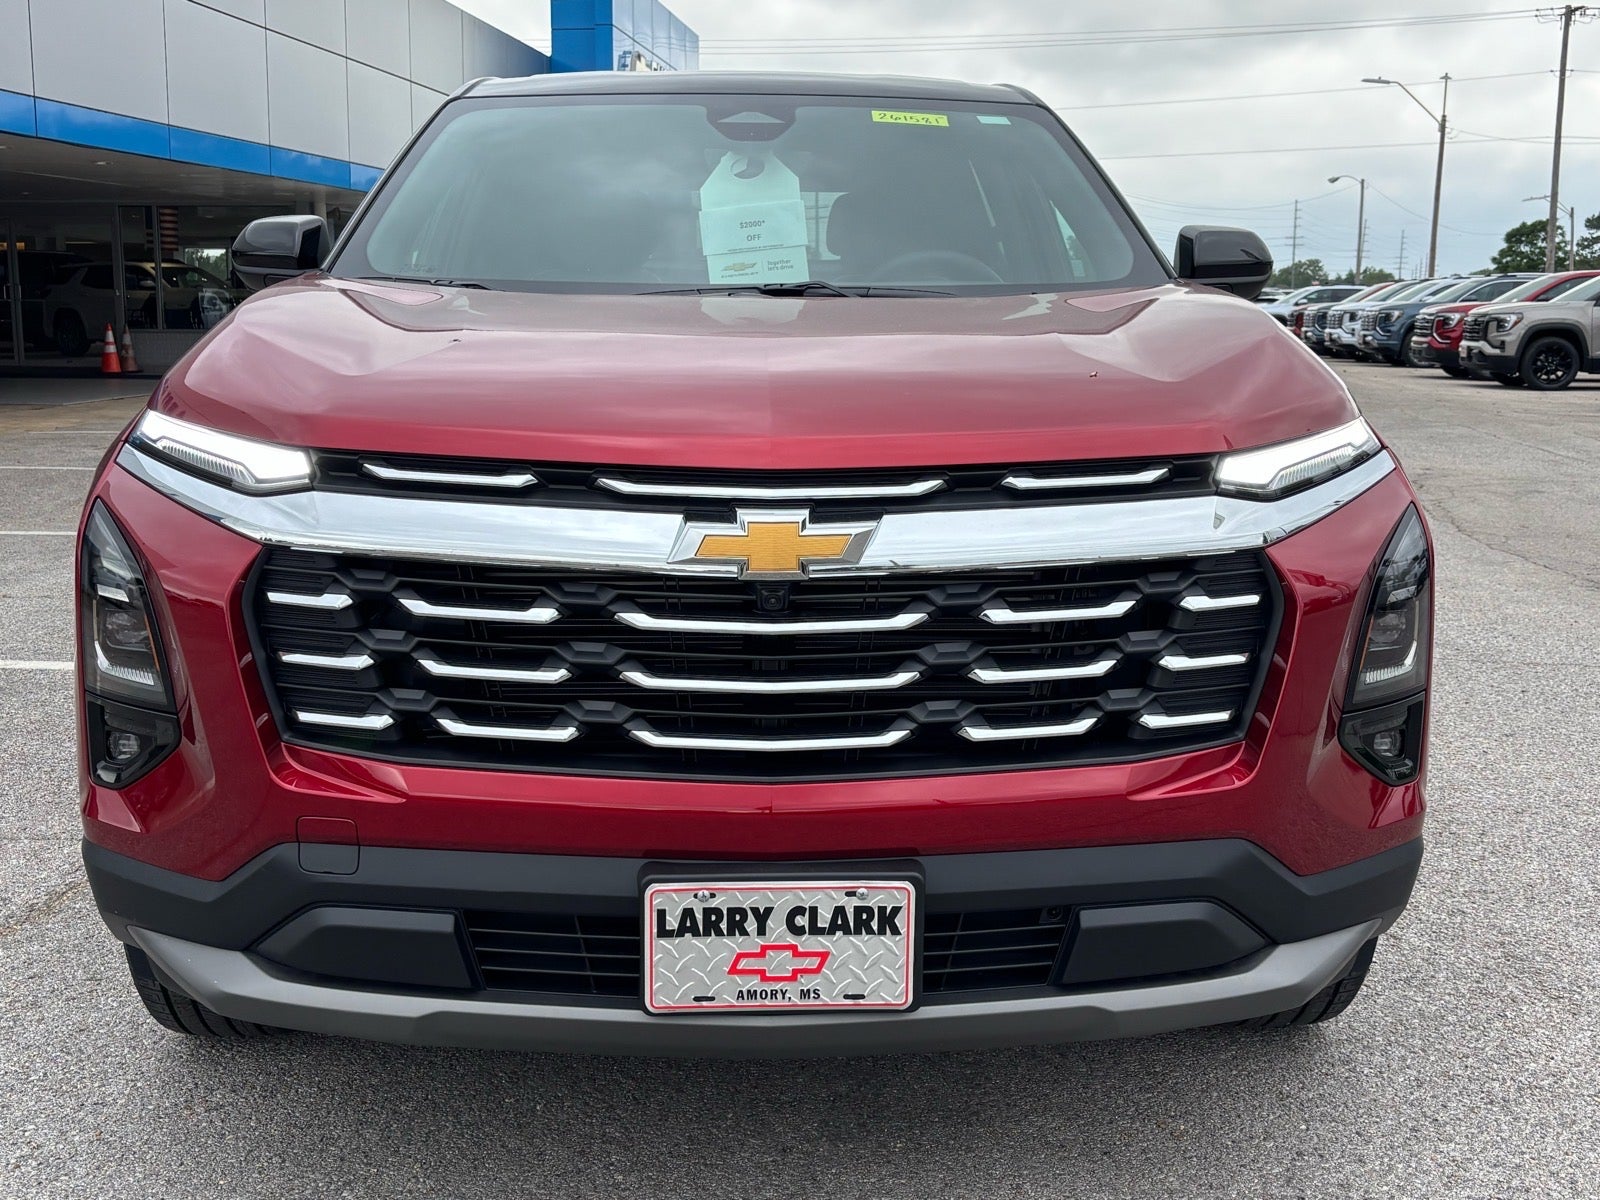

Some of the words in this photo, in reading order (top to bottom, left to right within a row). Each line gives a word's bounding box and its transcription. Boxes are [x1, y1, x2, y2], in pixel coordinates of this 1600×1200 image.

[656, 906, 774, 938] LARRY
[785, 905, 903, 936] CLARK
[736, 989, 792, 1002] AMORY,
[799, 988, 821, 1000] MS
